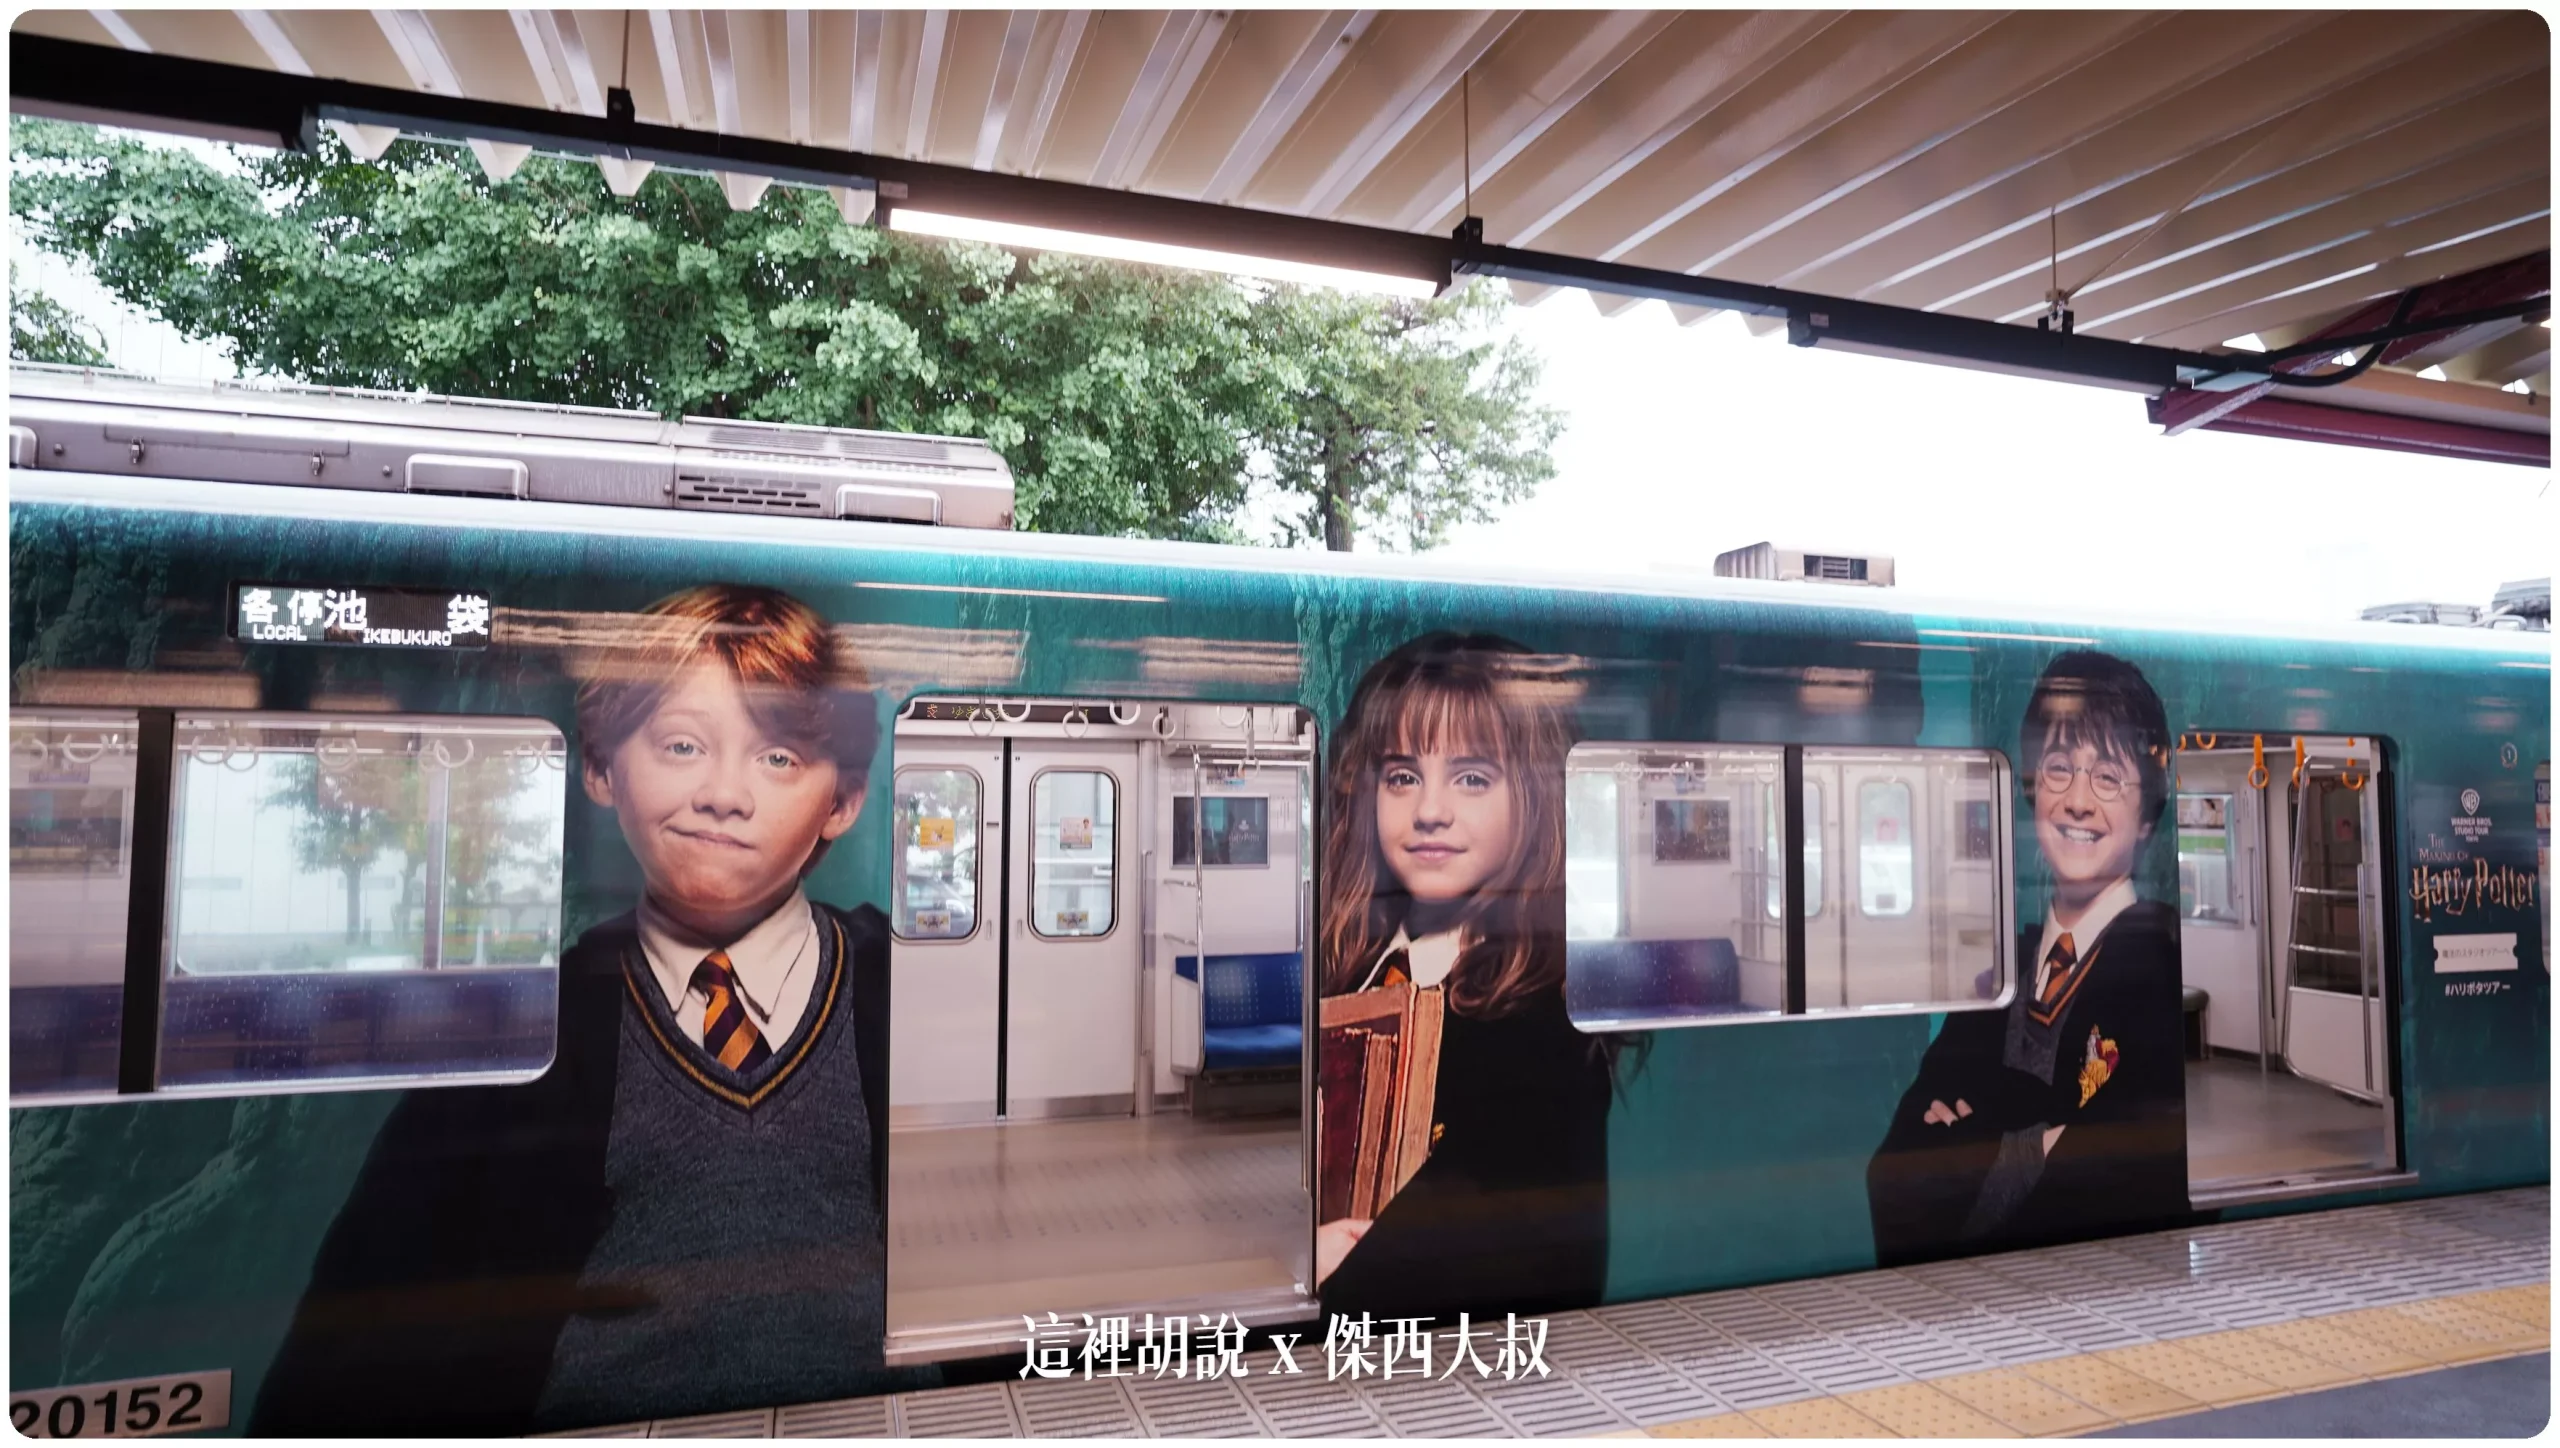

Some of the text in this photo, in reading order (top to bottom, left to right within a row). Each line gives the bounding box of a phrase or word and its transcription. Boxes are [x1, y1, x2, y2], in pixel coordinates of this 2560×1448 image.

[241, 588, 323, 626] 各停
[252, 624, 452, 647] LOCAL IKEBUKURO
[2409, 857, 2536, 923] Harry Potter
[9, 1381, 204, 1439] 20152
